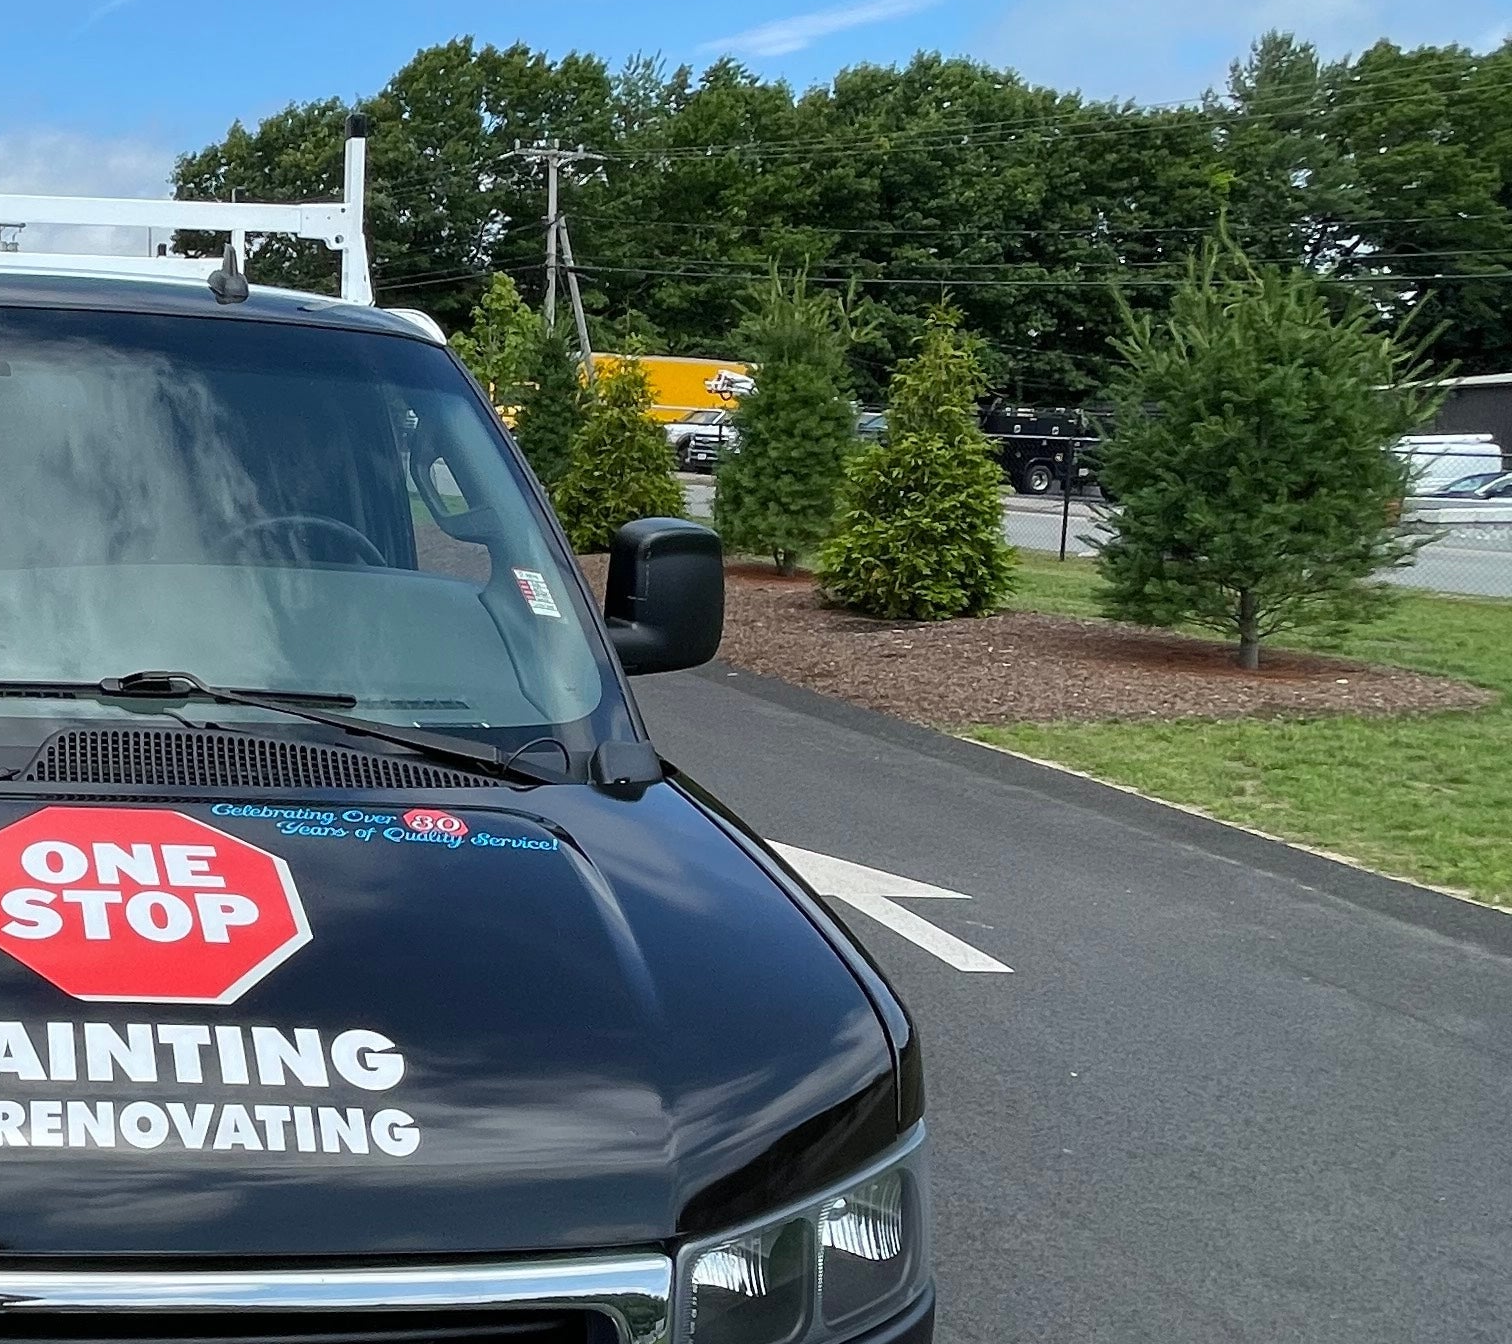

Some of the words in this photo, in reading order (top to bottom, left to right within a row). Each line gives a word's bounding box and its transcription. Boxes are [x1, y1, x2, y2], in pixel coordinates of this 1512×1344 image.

[211, 803, 338, 825] Celebrating
[342, 809, 397, 825] Over
[276, 821, 349, 837] Years
[355, 826, 378, 842] of
[383, 827, 465, 848] Quality
[470, 832, 559, 851] Service!
[21, 840, 225, 888] ONE
[0, 888, 260, 944] STOP
